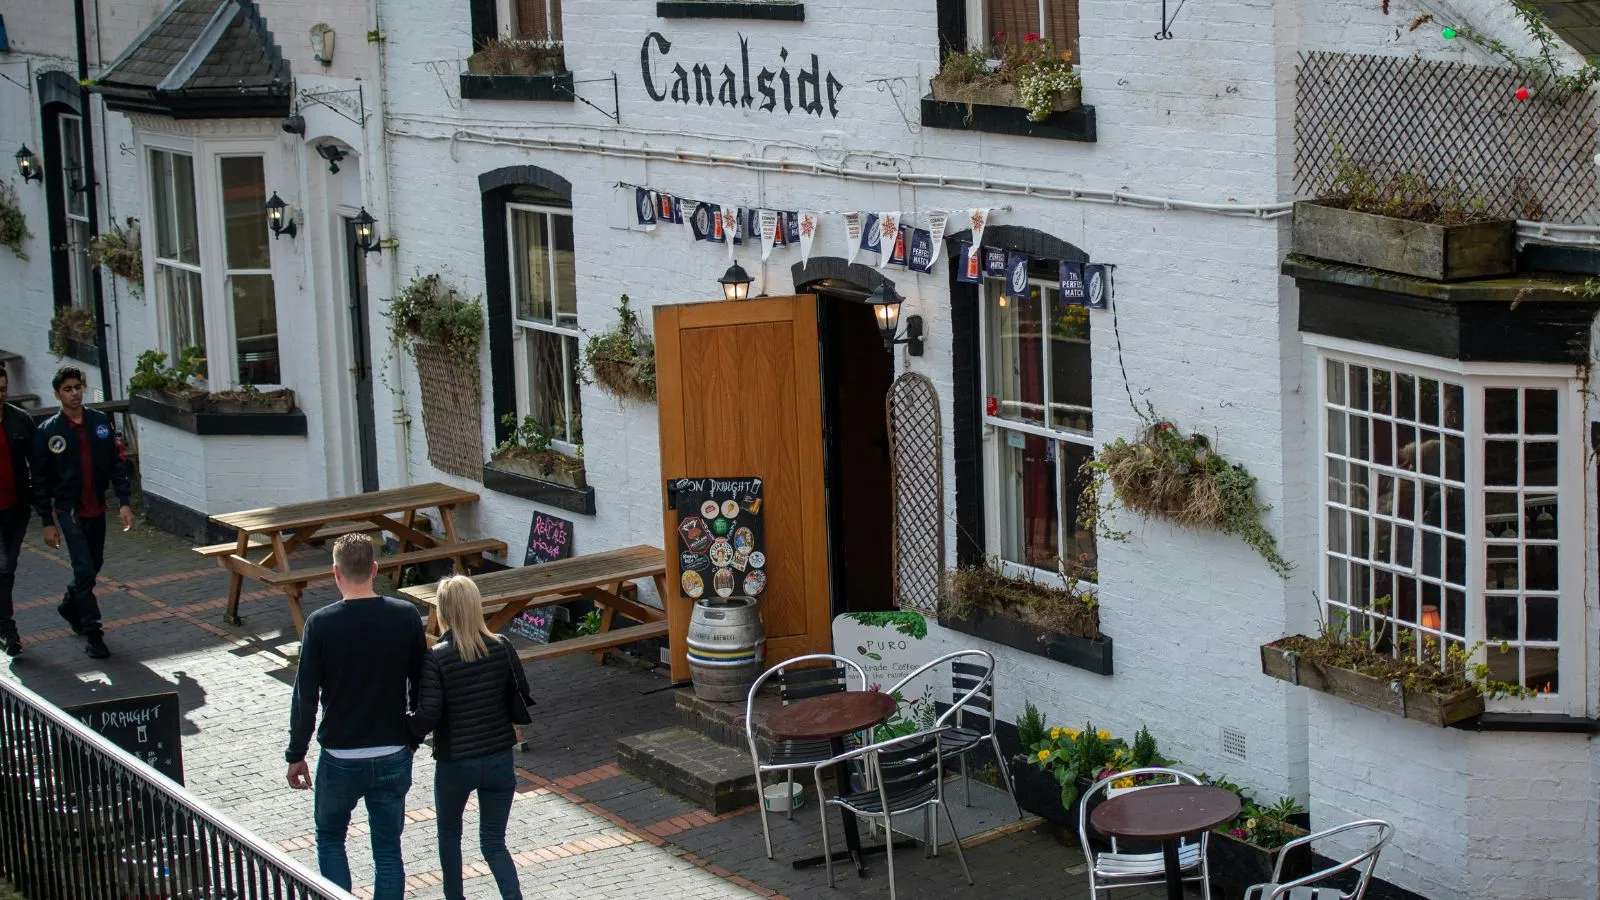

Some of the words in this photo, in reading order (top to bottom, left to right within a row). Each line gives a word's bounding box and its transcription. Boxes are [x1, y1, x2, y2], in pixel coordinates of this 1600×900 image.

[640, 31, 844, 119] Canalside
[866, 640, 907, 650] PURO
[101, 704, 161, 733] DRAUGHT
